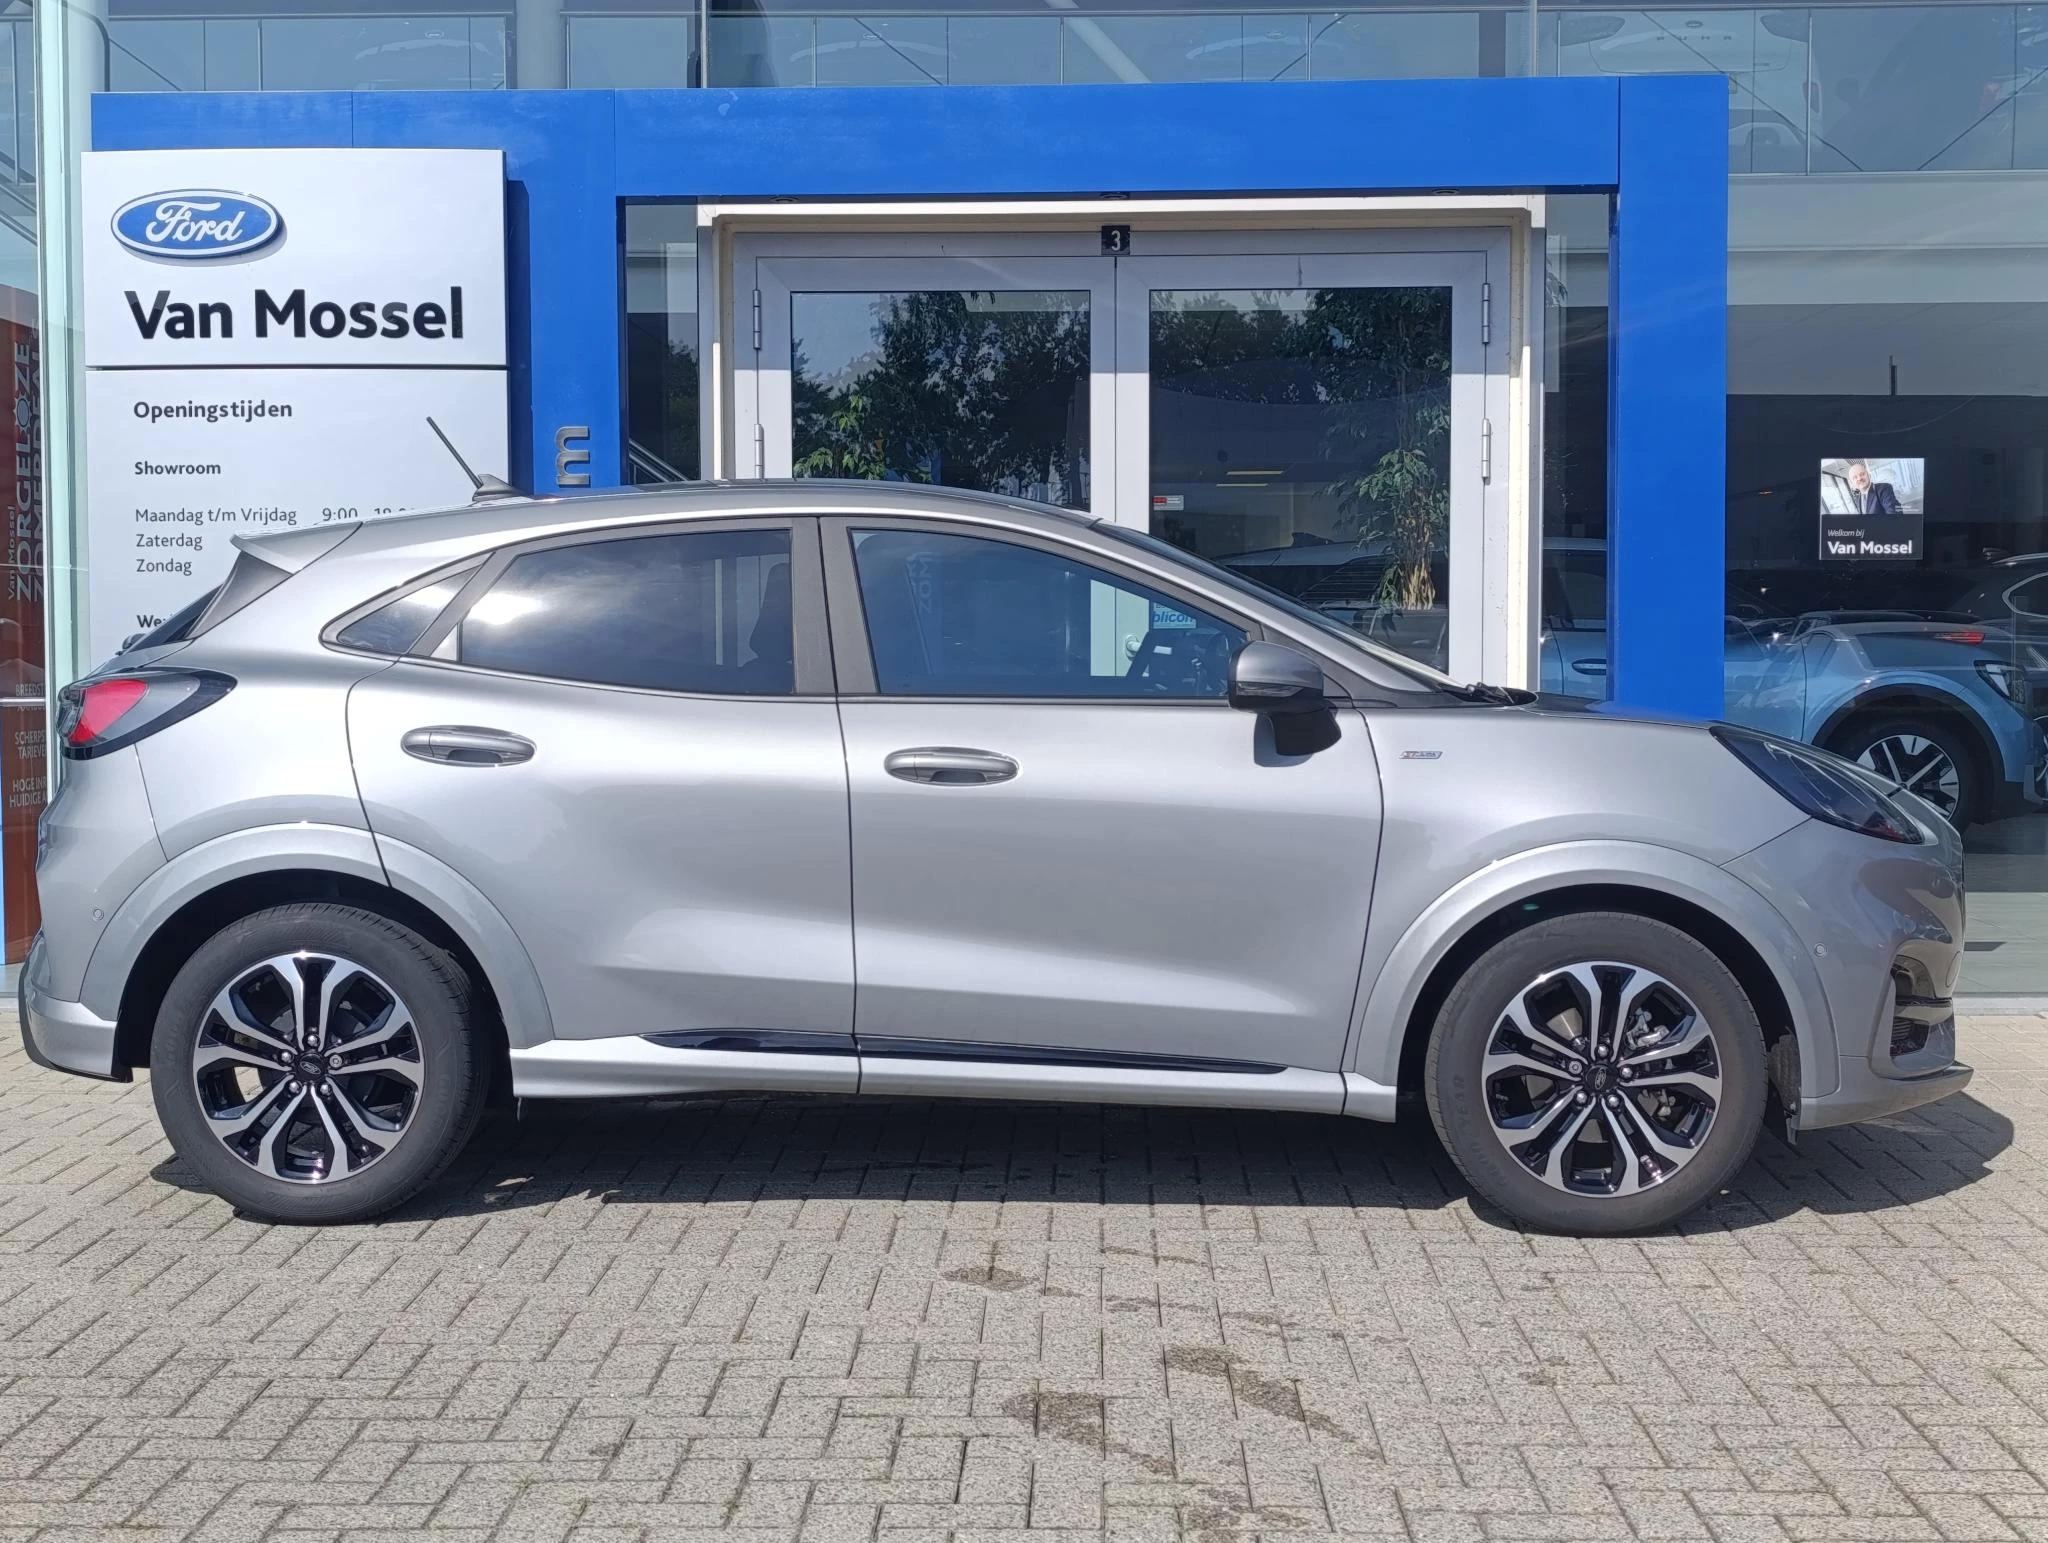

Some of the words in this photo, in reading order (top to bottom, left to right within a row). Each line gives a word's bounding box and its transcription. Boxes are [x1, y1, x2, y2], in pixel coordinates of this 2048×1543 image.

[146, 201, 246, 242] Ford
[1111, 230, 1121, 251] 3
[124, 289, 234, 339] Van
[254, 286, 464, 340] Mossel
[133, 399, 293, 424] Openingstijden
[134, 461, 222, 475] Showroom
[135, 509, 204, 525] Maandag
[207, 508, 236, 522] t/m
[242, 508, 297, 525] Vrijdag
[7, 505, 16, 564] Mossel
[1828, 529, 1854, 537] Welkom
[1856, 529, 1865, 538] bij
[136, 534, 203, 551] Zaterdag
[1827, 541, 1855, 554] Van
[1860, 540, 1912, 554] Mossel
[136, 559, 193, 576] Zondag
[8, 569, 16, 600] Van
[12, 777, 35, 793] HOGE
[9, 791, 42, 808] HUIDIGE
